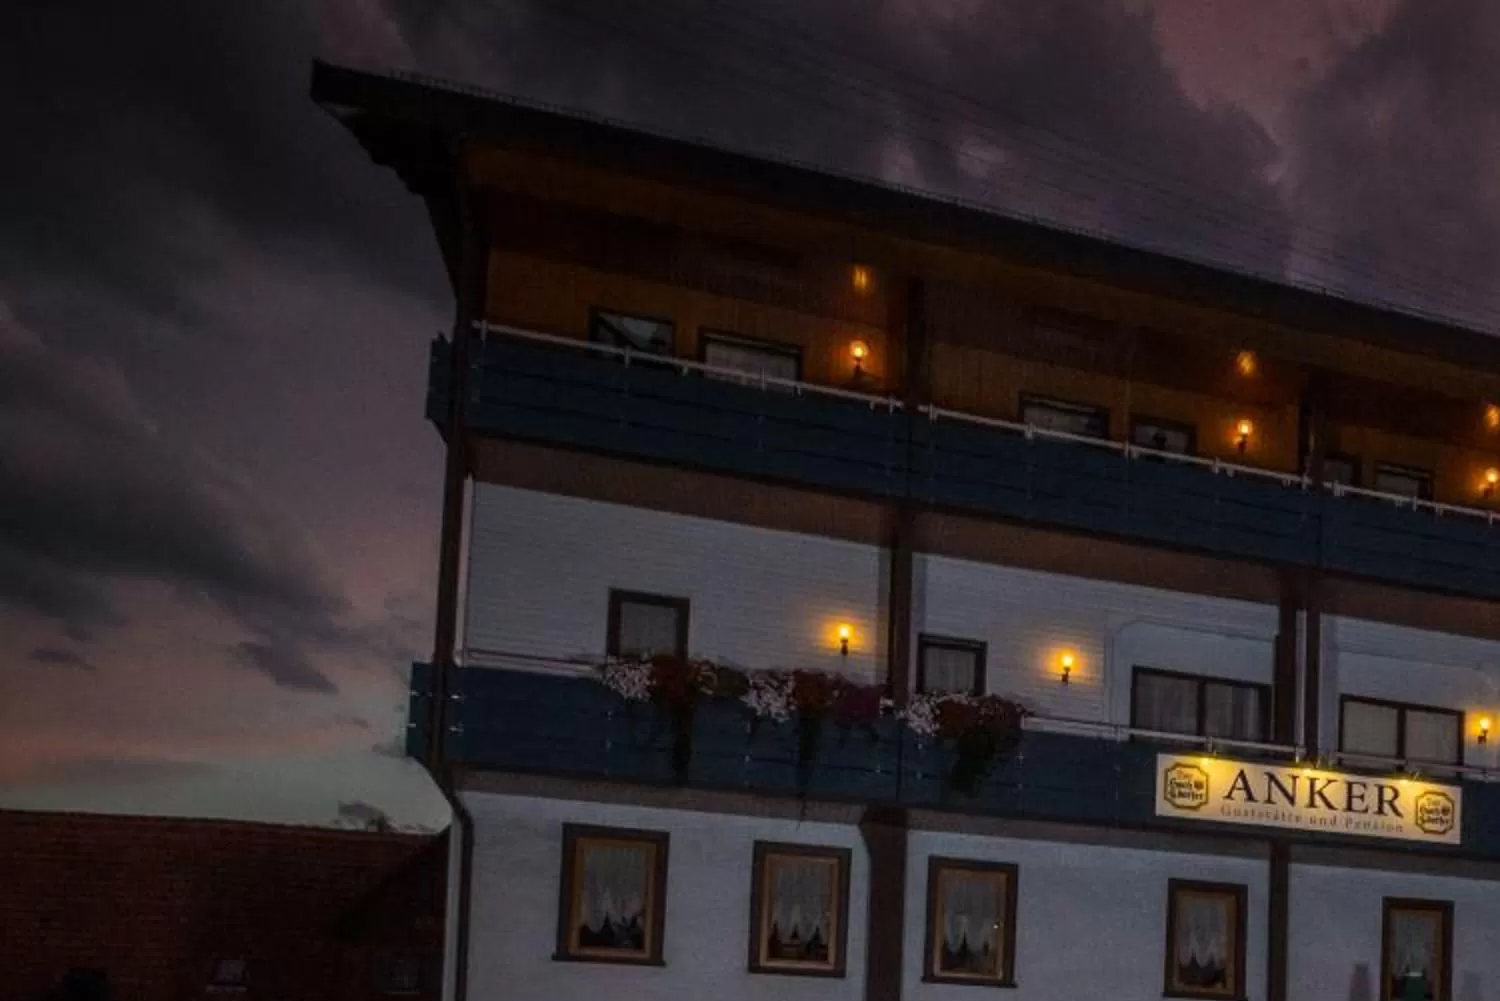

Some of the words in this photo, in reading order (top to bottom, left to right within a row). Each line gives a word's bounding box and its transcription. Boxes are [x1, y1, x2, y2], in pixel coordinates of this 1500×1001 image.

[1223, 769, 1404, 818] ANKER
[1309, 815, 1338, 827] und
[1344, 817, 1404, 834] Pension
